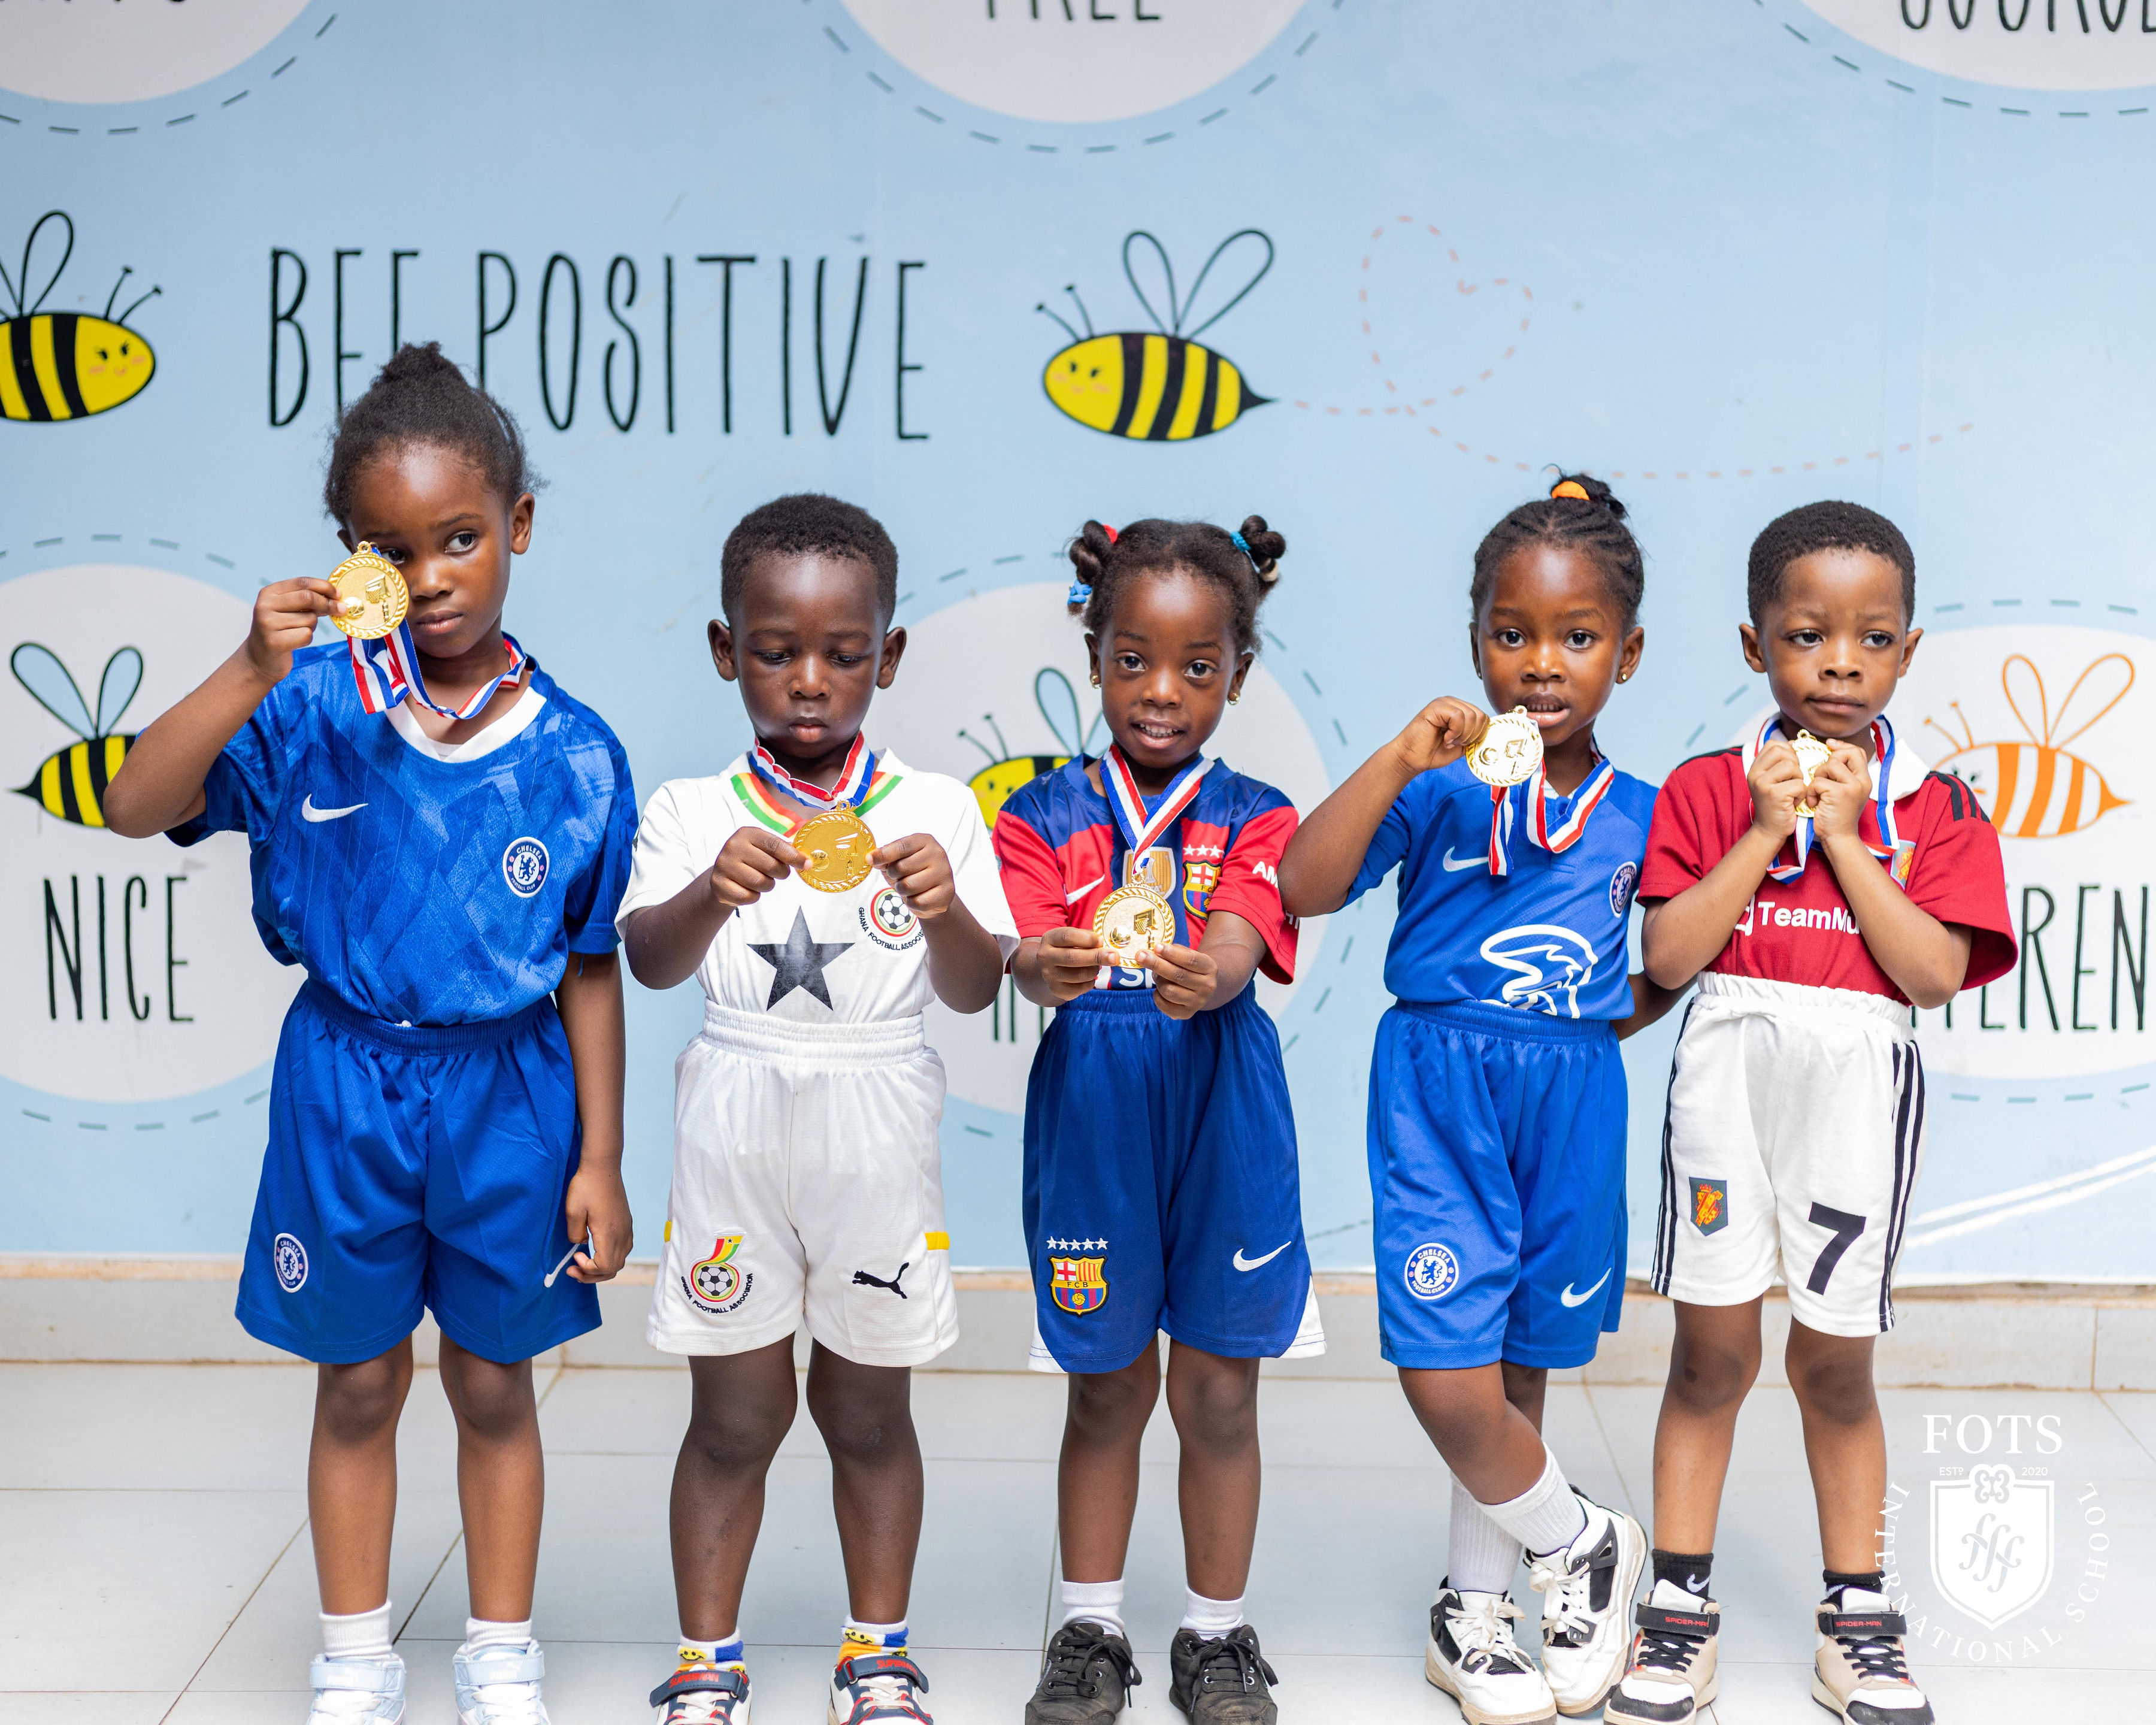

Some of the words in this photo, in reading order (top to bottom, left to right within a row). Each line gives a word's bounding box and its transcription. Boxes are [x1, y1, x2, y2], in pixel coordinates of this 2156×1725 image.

[477, 250, 930, 441] POSITIVE
[516, 845, 543, 861] CHELSEA
[858, 907, 870, 932] GHANA
[867, 931, 901, 951] FOOTBALL
[1758, 901, 1860, 935] TeamMu
[44, 874, 195, 1022] NICE
[280, 1240, 302, 1258] CHELSEA
[1417, 1248, 1451, 1264] CHELSEA
[1806, 1201, 1867, 1296] 7
[680, 1276, 693, 1300] GHANA
[692, 1299, 729, 1314] FOOTBALL
[1412, 1279, 1431, 1294] FOOTBALL
[1431, 1284, 1445, 1294] CLUB
[669, 1672, 720, 1688] SUPERMAN
